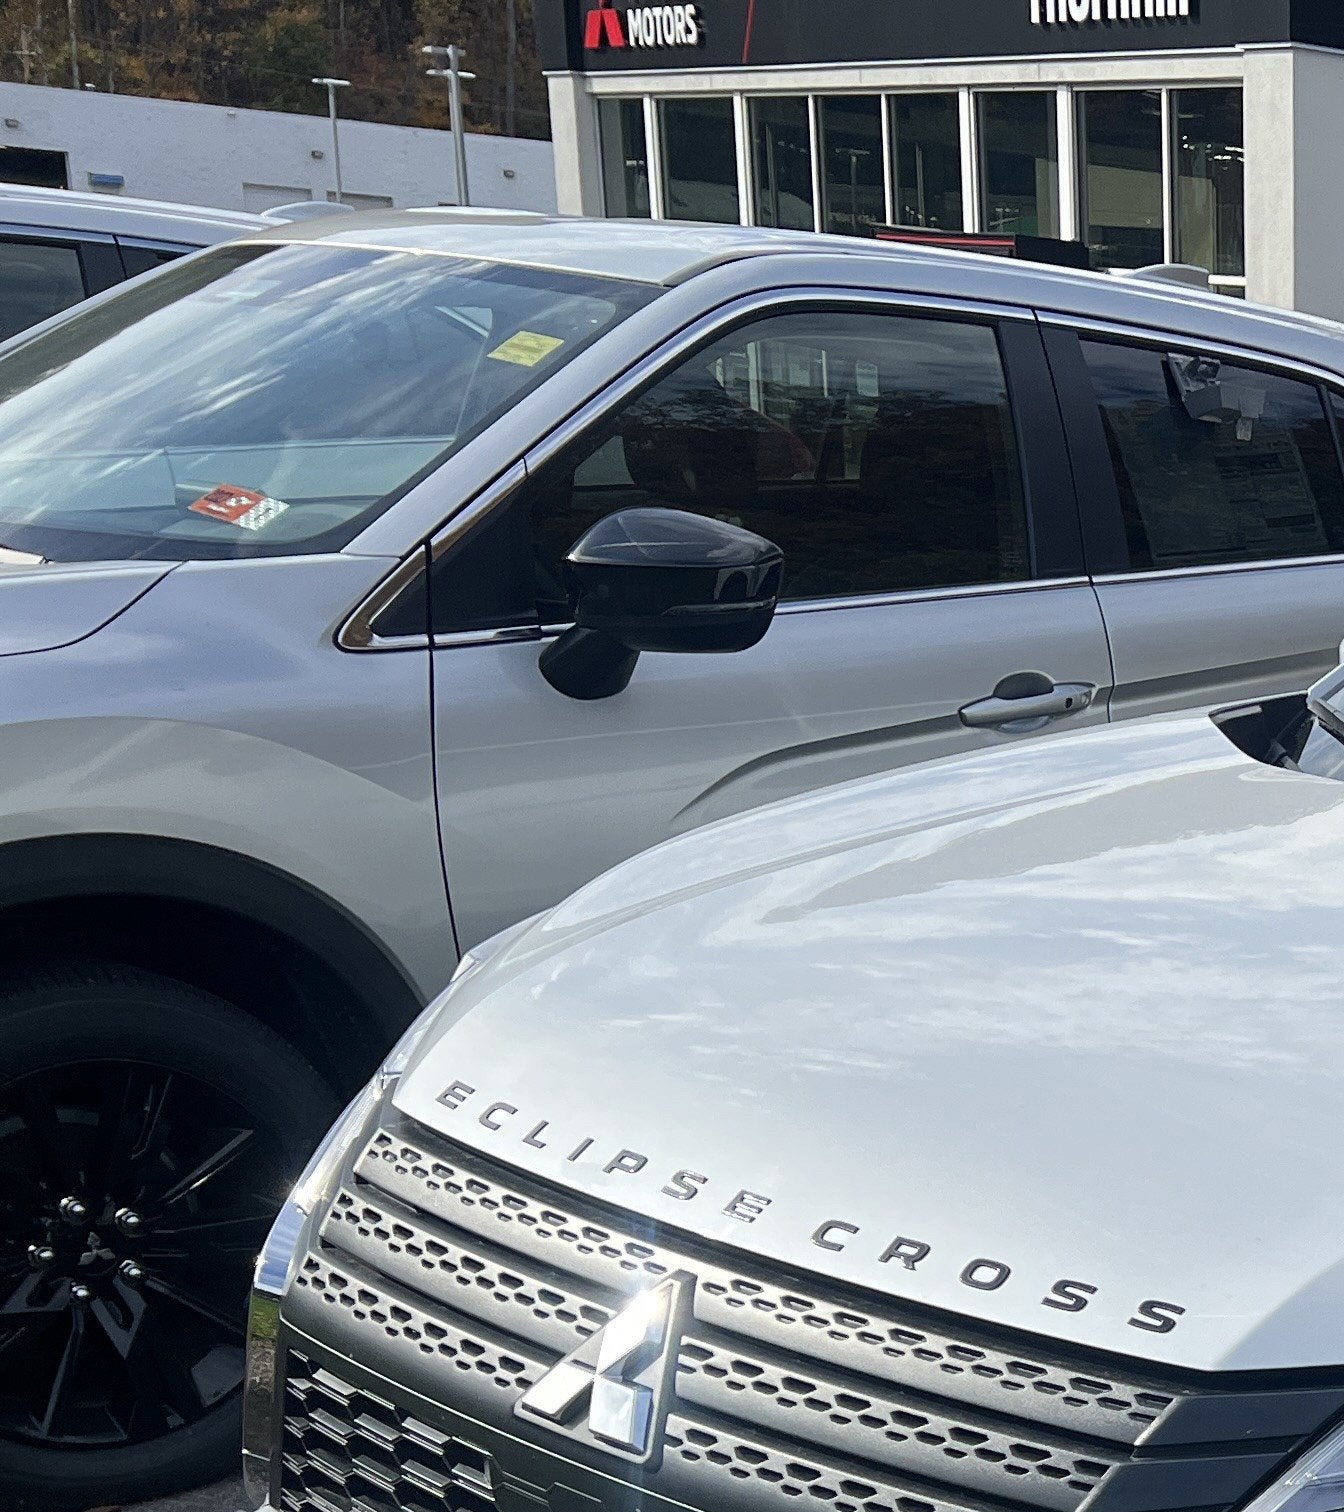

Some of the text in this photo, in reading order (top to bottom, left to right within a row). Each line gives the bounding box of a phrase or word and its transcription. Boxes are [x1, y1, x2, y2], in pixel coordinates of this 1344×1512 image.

[626, 4, 698, 47] MOTORS
[434, 1079, 1187, 1336] ECLIPSE CROSS
